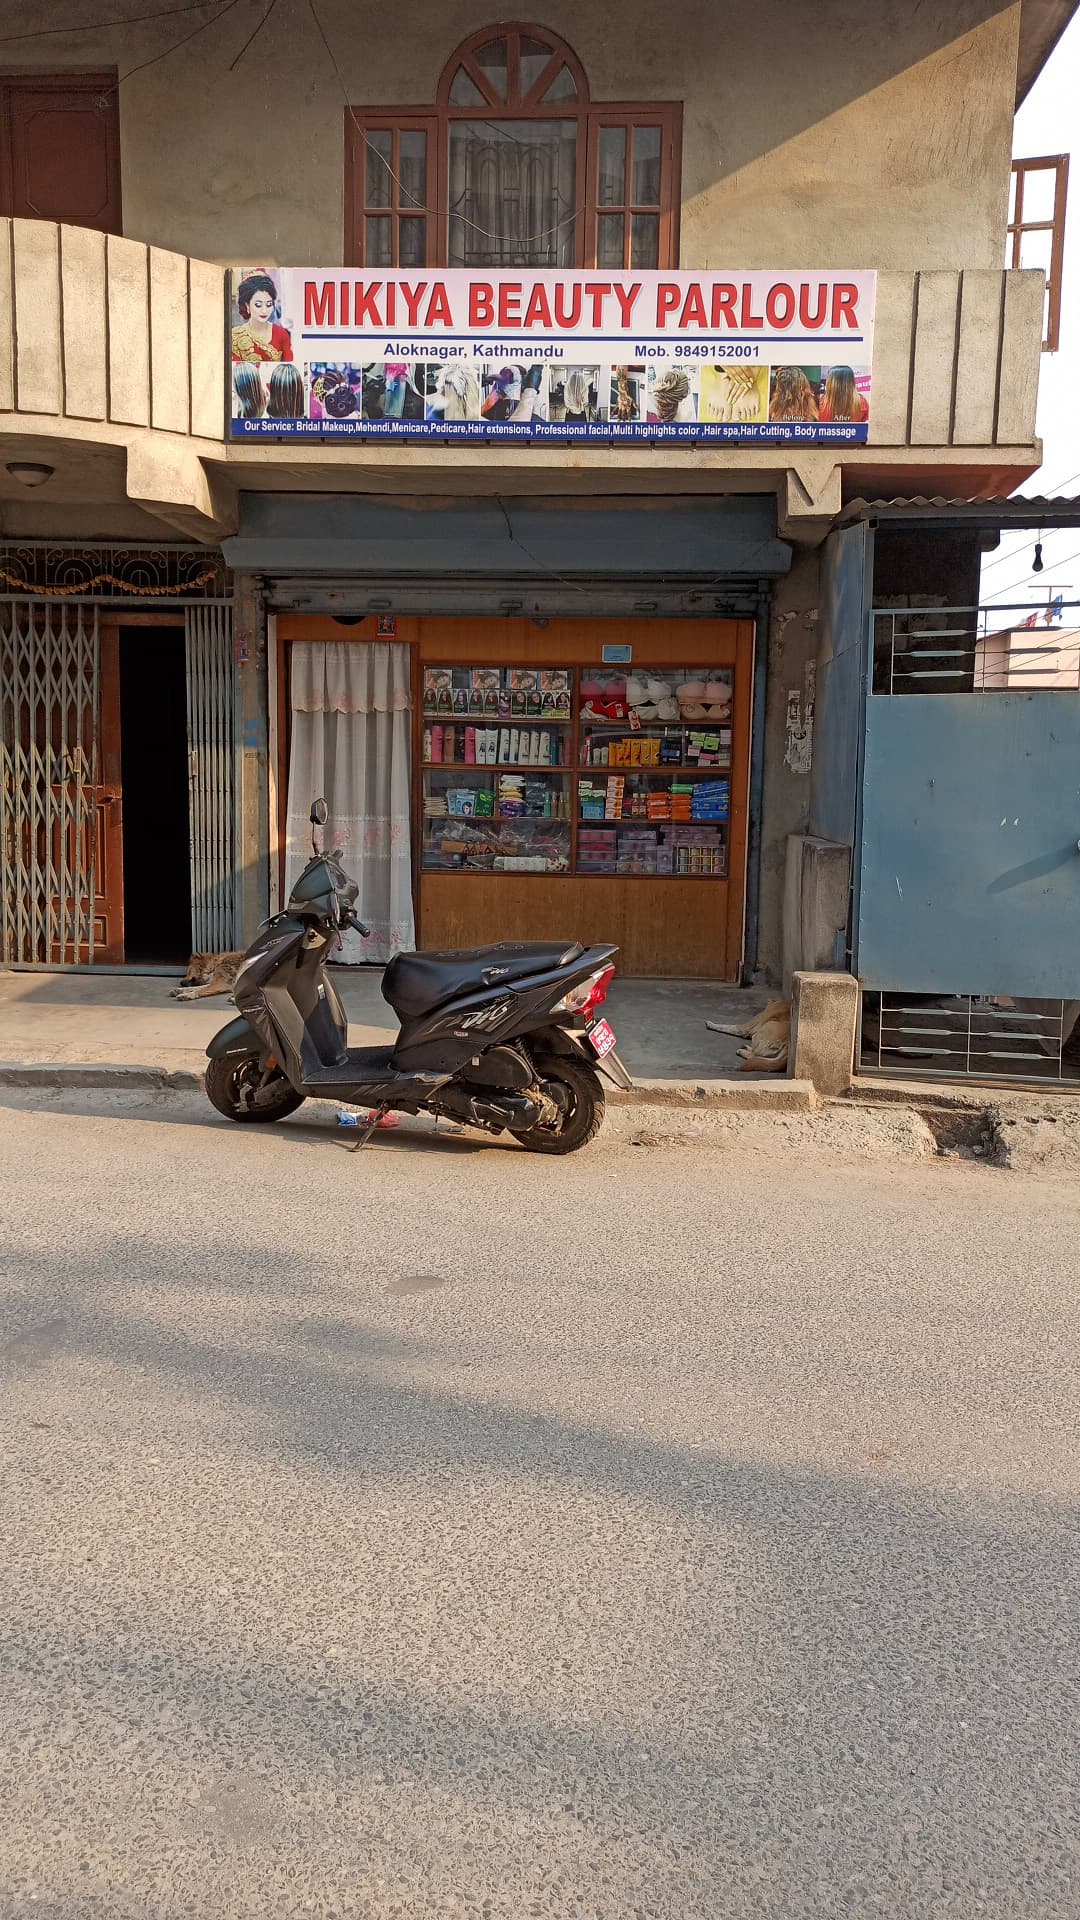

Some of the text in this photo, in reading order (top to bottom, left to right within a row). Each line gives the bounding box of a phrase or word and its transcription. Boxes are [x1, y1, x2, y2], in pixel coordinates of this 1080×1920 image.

[304, 281, 859, 330] MIKIYA BEAUTY PARLOUR
[383, 343, 564, 359] Aloknagar, Kathmandu
[635, 345, 760, 357] Mob. 9849152001
[244, 420, 260, 431] Our
[262, 420, 295, 431] Service:
[296, 420, 321, 432] Bridal
[487, 423, 534, 436] extensions,
[536, 424, 587, 435] Professional
[634, 424, 677, 438] highlights
[677, 425, 701, 436] color
[759, 425, 793, 439] Cutting,
[794, 425, 817, 438] Body
[818, 427, 857, 439] massage
